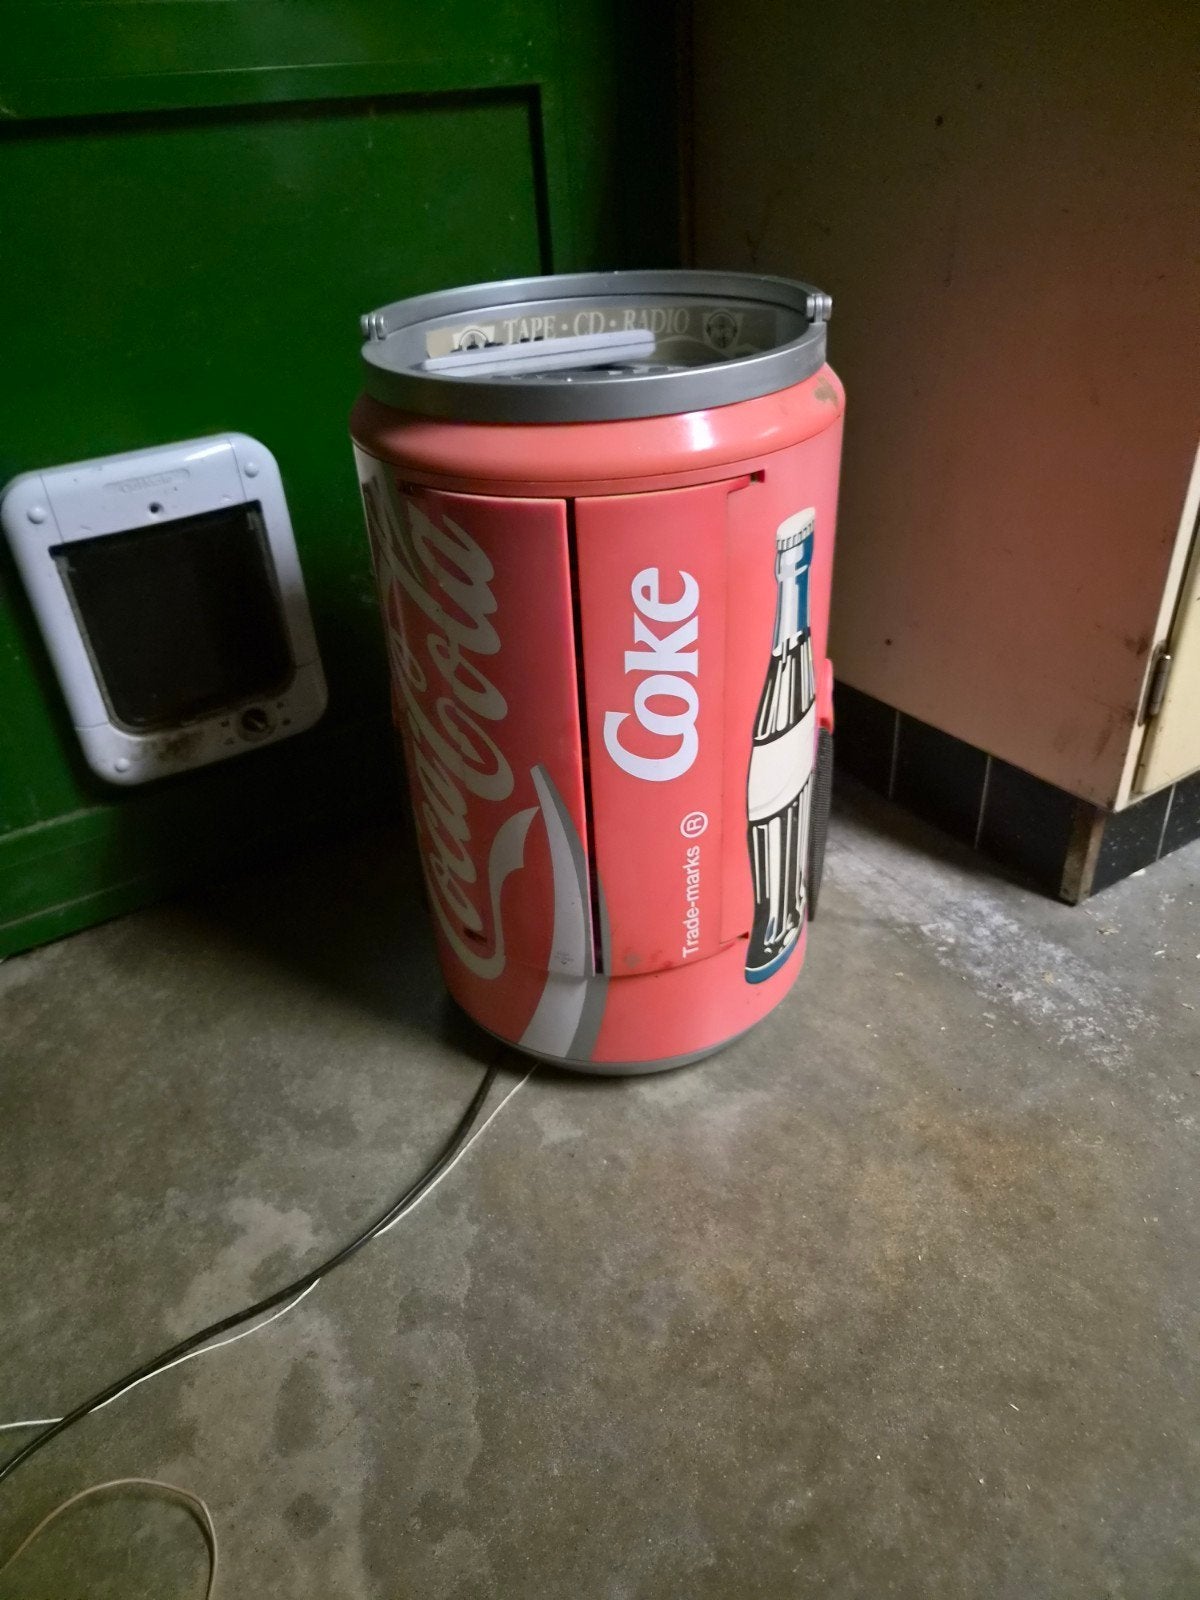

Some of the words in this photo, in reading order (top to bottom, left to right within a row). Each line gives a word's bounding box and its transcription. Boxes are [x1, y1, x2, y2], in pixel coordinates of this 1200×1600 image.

[502, 314, 557, 344] TAPE
[573, 310, 606, 337] CD
[623, 307, 691, 334] RADIO
[603, 567, 700, 782] Coke
[682, 845, 701, 959] Trade-marks
